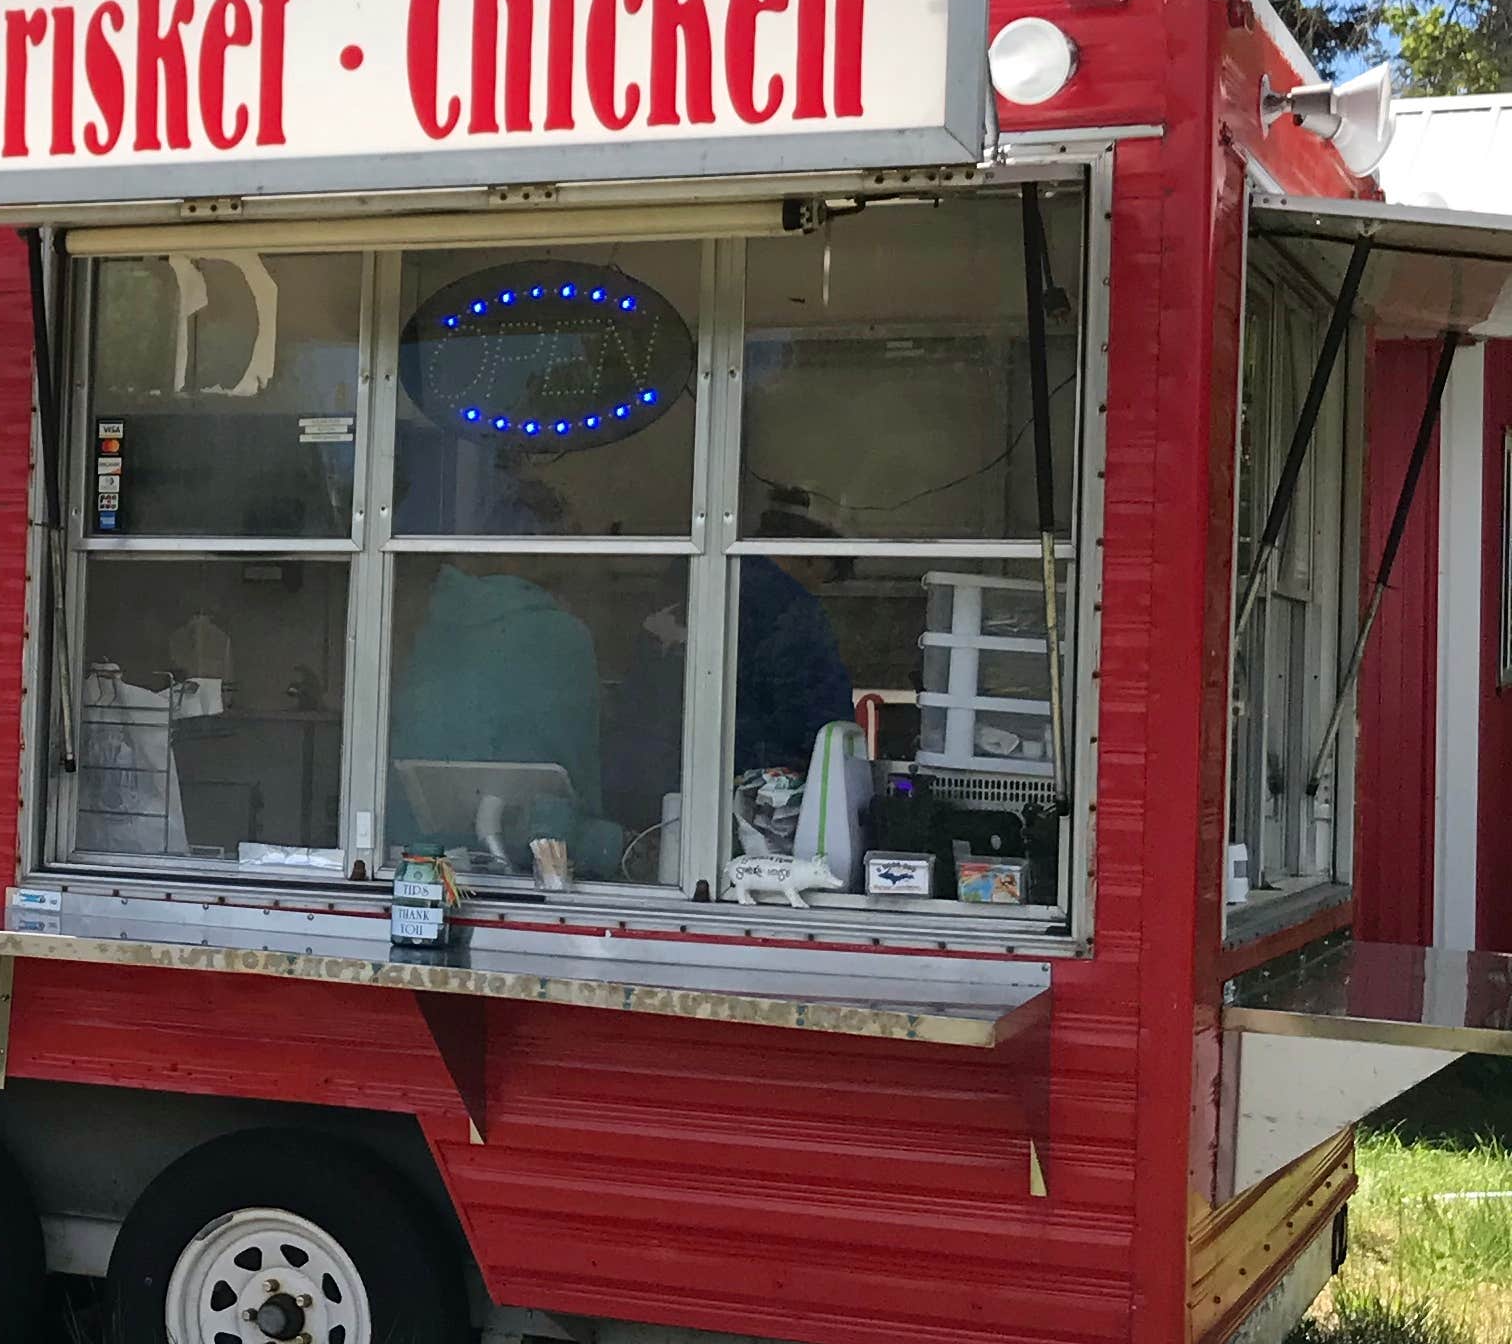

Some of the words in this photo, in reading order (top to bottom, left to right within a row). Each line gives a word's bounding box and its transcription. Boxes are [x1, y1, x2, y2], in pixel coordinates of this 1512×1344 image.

[430, 315, 660, 399] OPEN
[403, 884, 430, 897] TIPS
[398, 908, 430, 921] THANK
[400, 923, 423, 936] YOU
